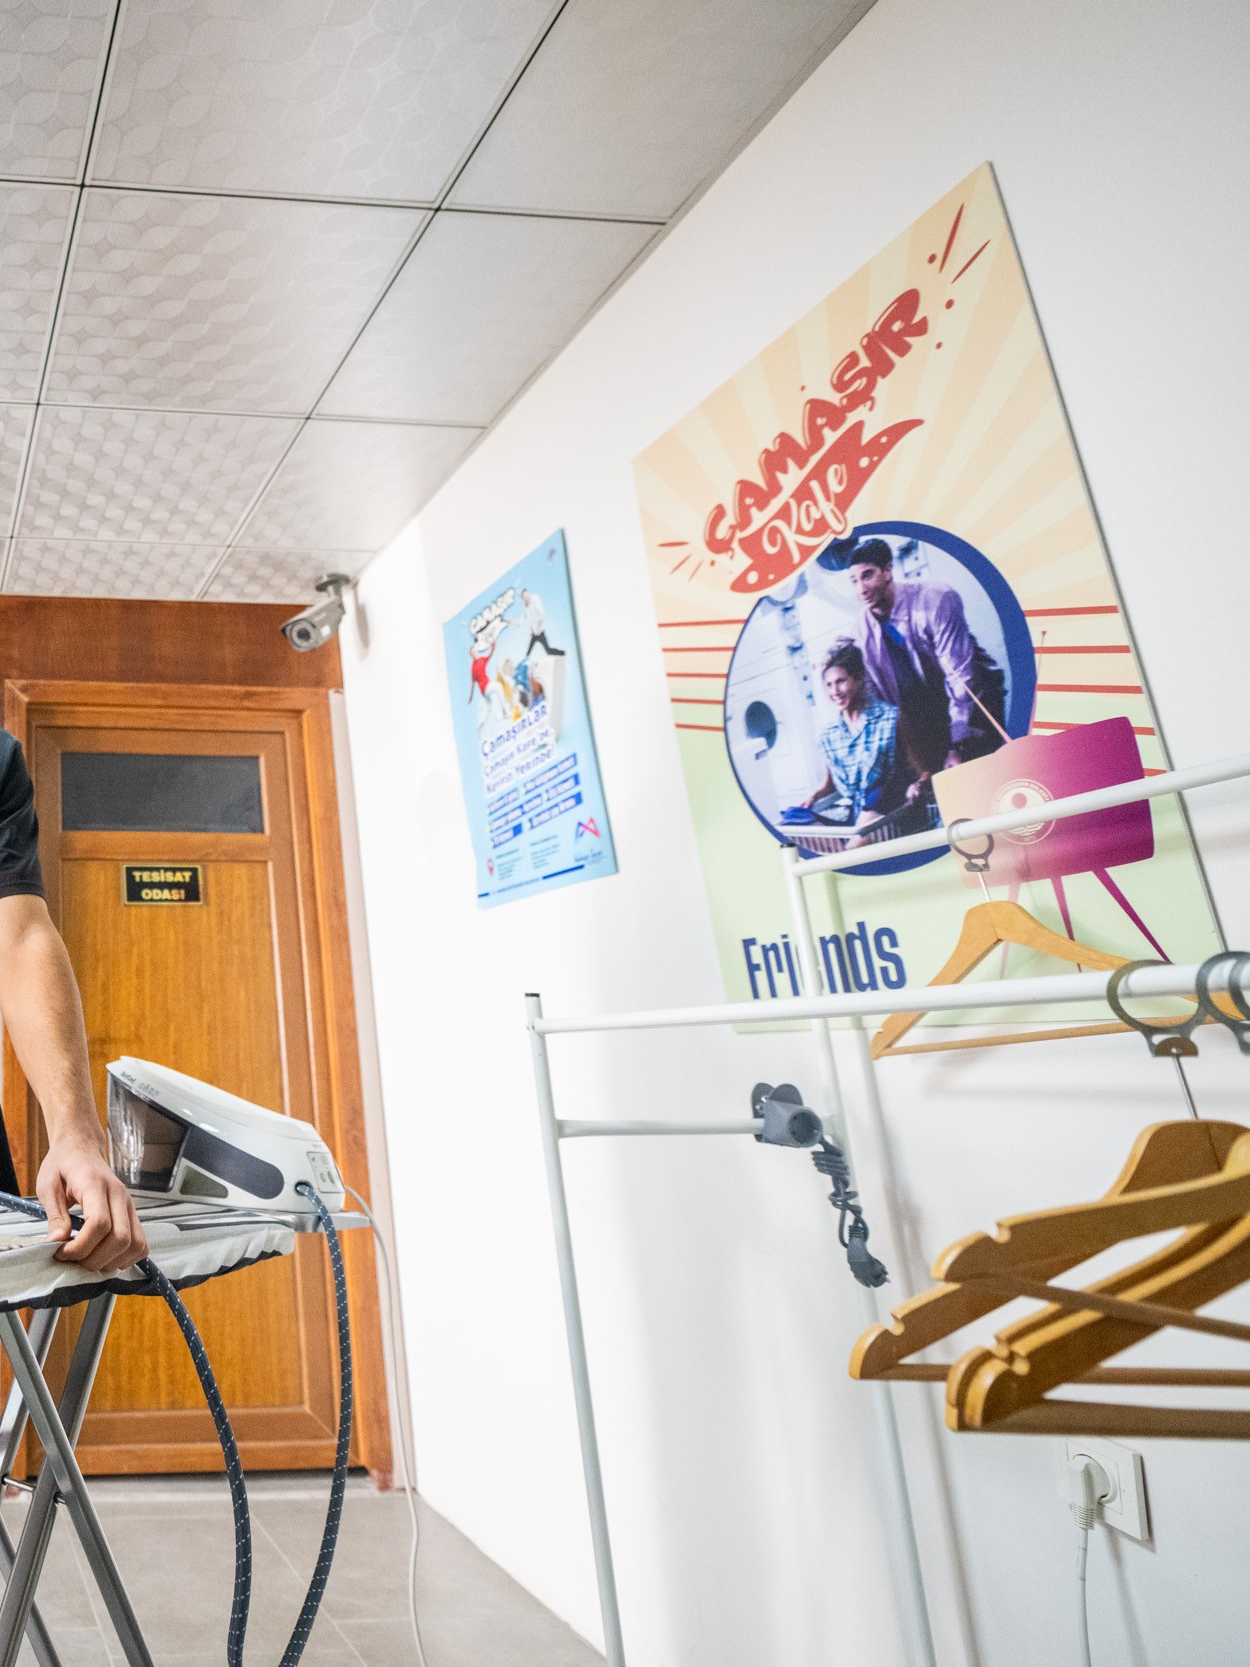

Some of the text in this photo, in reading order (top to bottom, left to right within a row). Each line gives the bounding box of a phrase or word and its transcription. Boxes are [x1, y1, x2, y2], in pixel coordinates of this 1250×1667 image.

[704, 289, 928, 560] ÇAMAŞIR
[761, 463, 848, 566] Kafe
[132, 869, 192, 882] TESİSAT
[141, 888, 185, 900] ODASI
[742, 921, 907, 1000] Frinds
